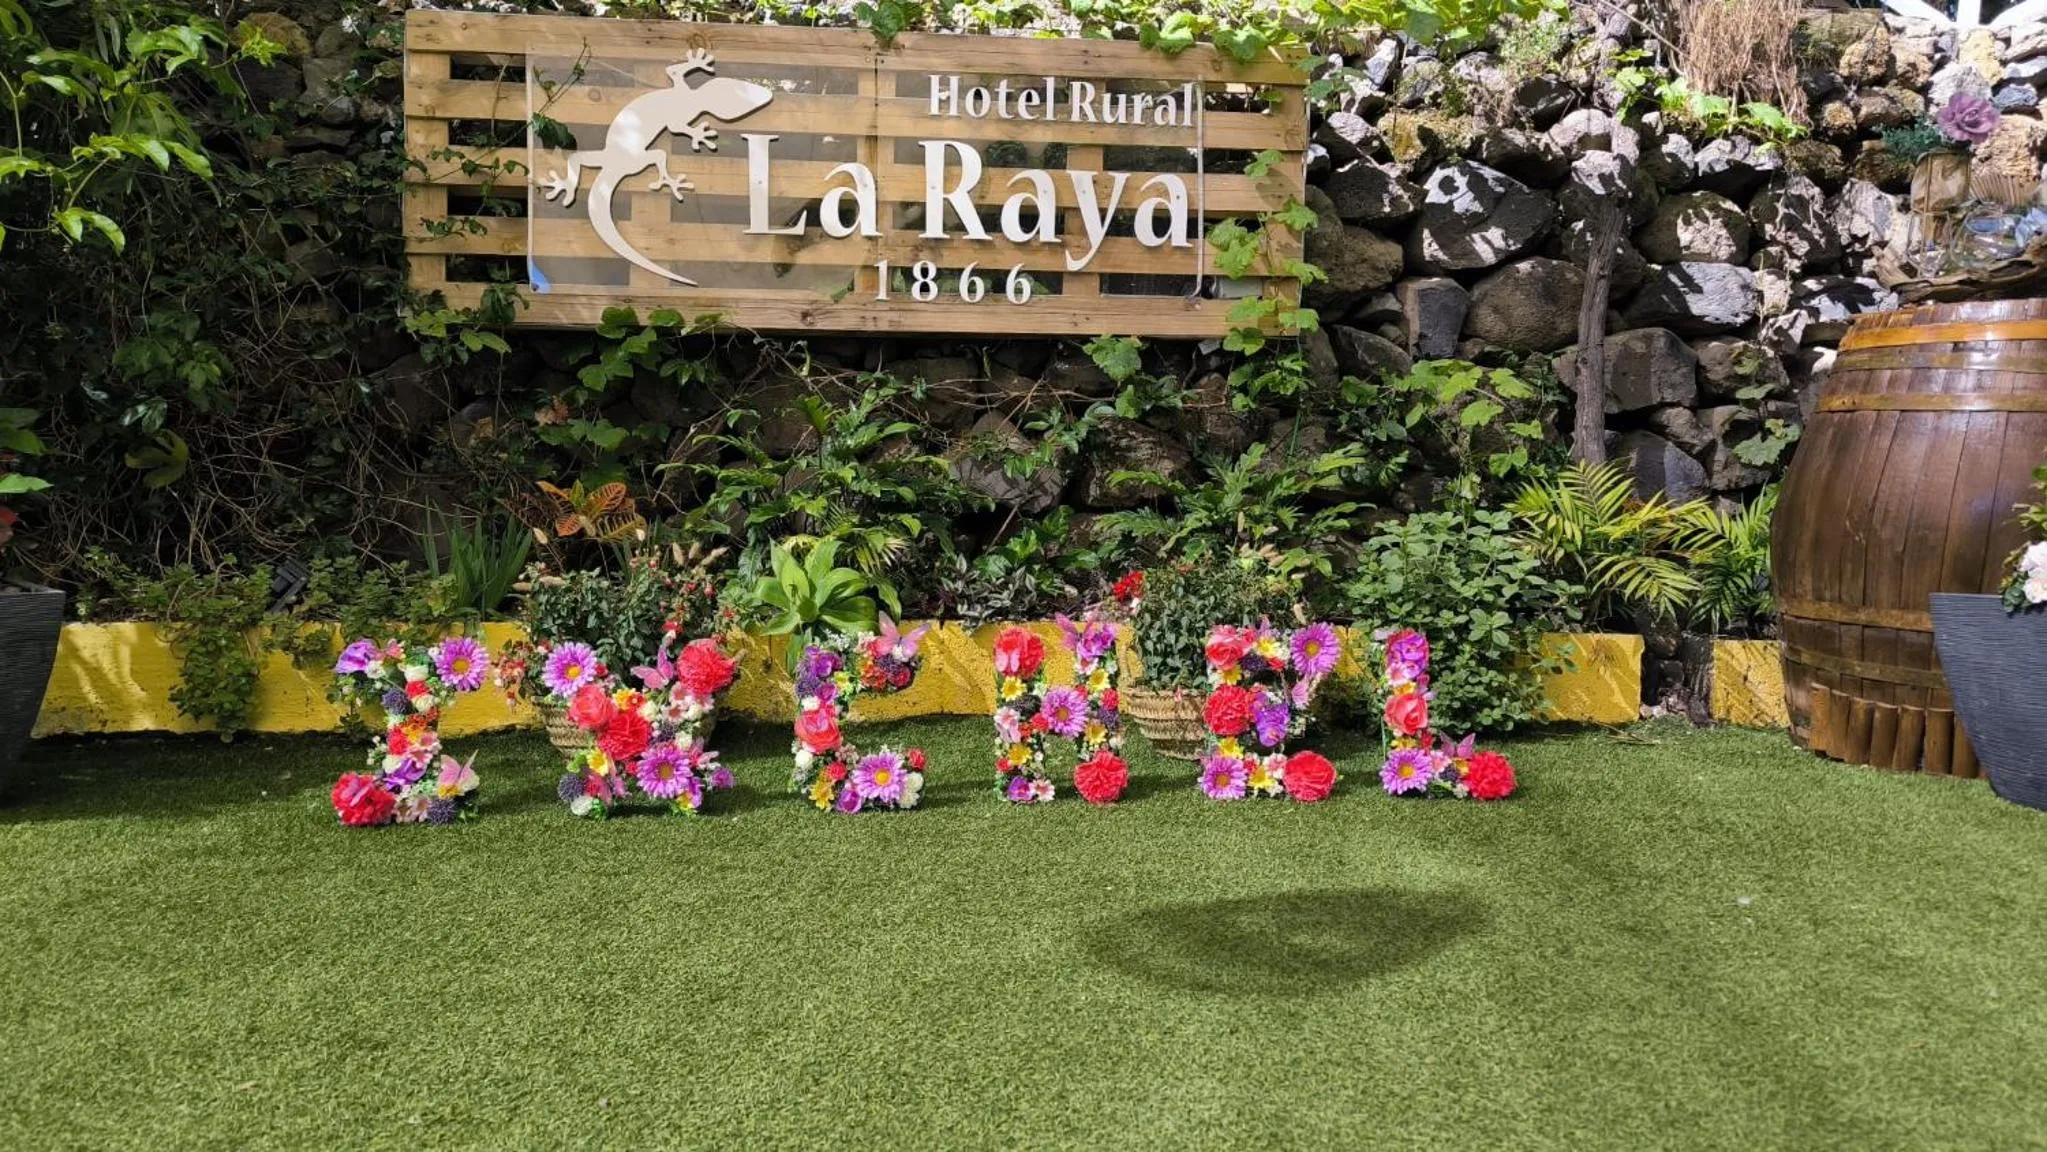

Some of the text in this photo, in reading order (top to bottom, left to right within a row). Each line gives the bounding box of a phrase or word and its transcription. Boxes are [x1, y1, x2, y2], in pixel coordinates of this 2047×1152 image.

[928, 74, 1193, 127] Hotel Rural
[740, 133, 1193, 271] La Raya
[874, 260, 1033, 304] 1866
